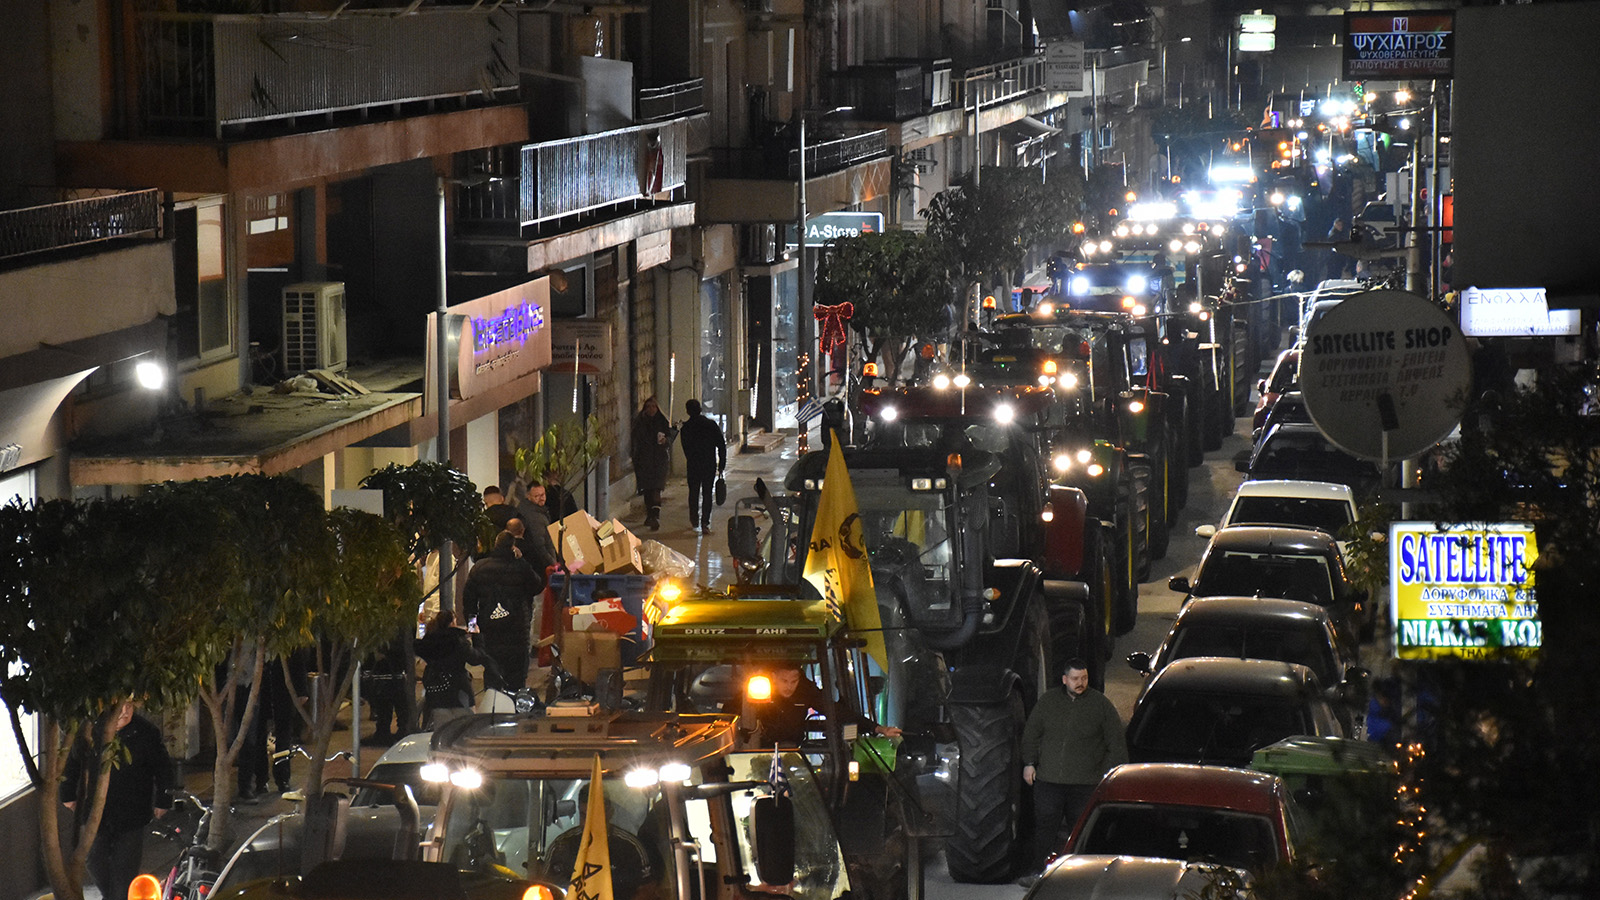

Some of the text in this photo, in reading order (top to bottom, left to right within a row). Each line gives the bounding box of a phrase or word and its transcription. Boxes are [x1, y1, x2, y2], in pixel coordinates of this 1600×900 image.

[1354, 33, 1447, 50] ΨΥΧΙΑΤΡΟΣ
[1360, 50, 1440, 59] ΨΥΧΟΘΕΡΑΠΕΥΤΗΣ
[1350, 59, 1449, 69] ΠΑΠΟΥΤΣΗΣ ΕΥΑΓΓΕΛΟΣ
[809, 224, 858, 238] A-Store
[1313, 326, 1451, 355] SATELLITE SHOP
[1401, 534, 1527, 584] SATELLITE
[1422, 588, 1508, 601] ΔΟΡΥΦΟΡΙΚΑ
[1515, 589, 1526, 601] &
[490, 610, 510, 620] adidas
[1429, 604, 1507, 616] ΣΥΣΤΗΜΑΤΑ
